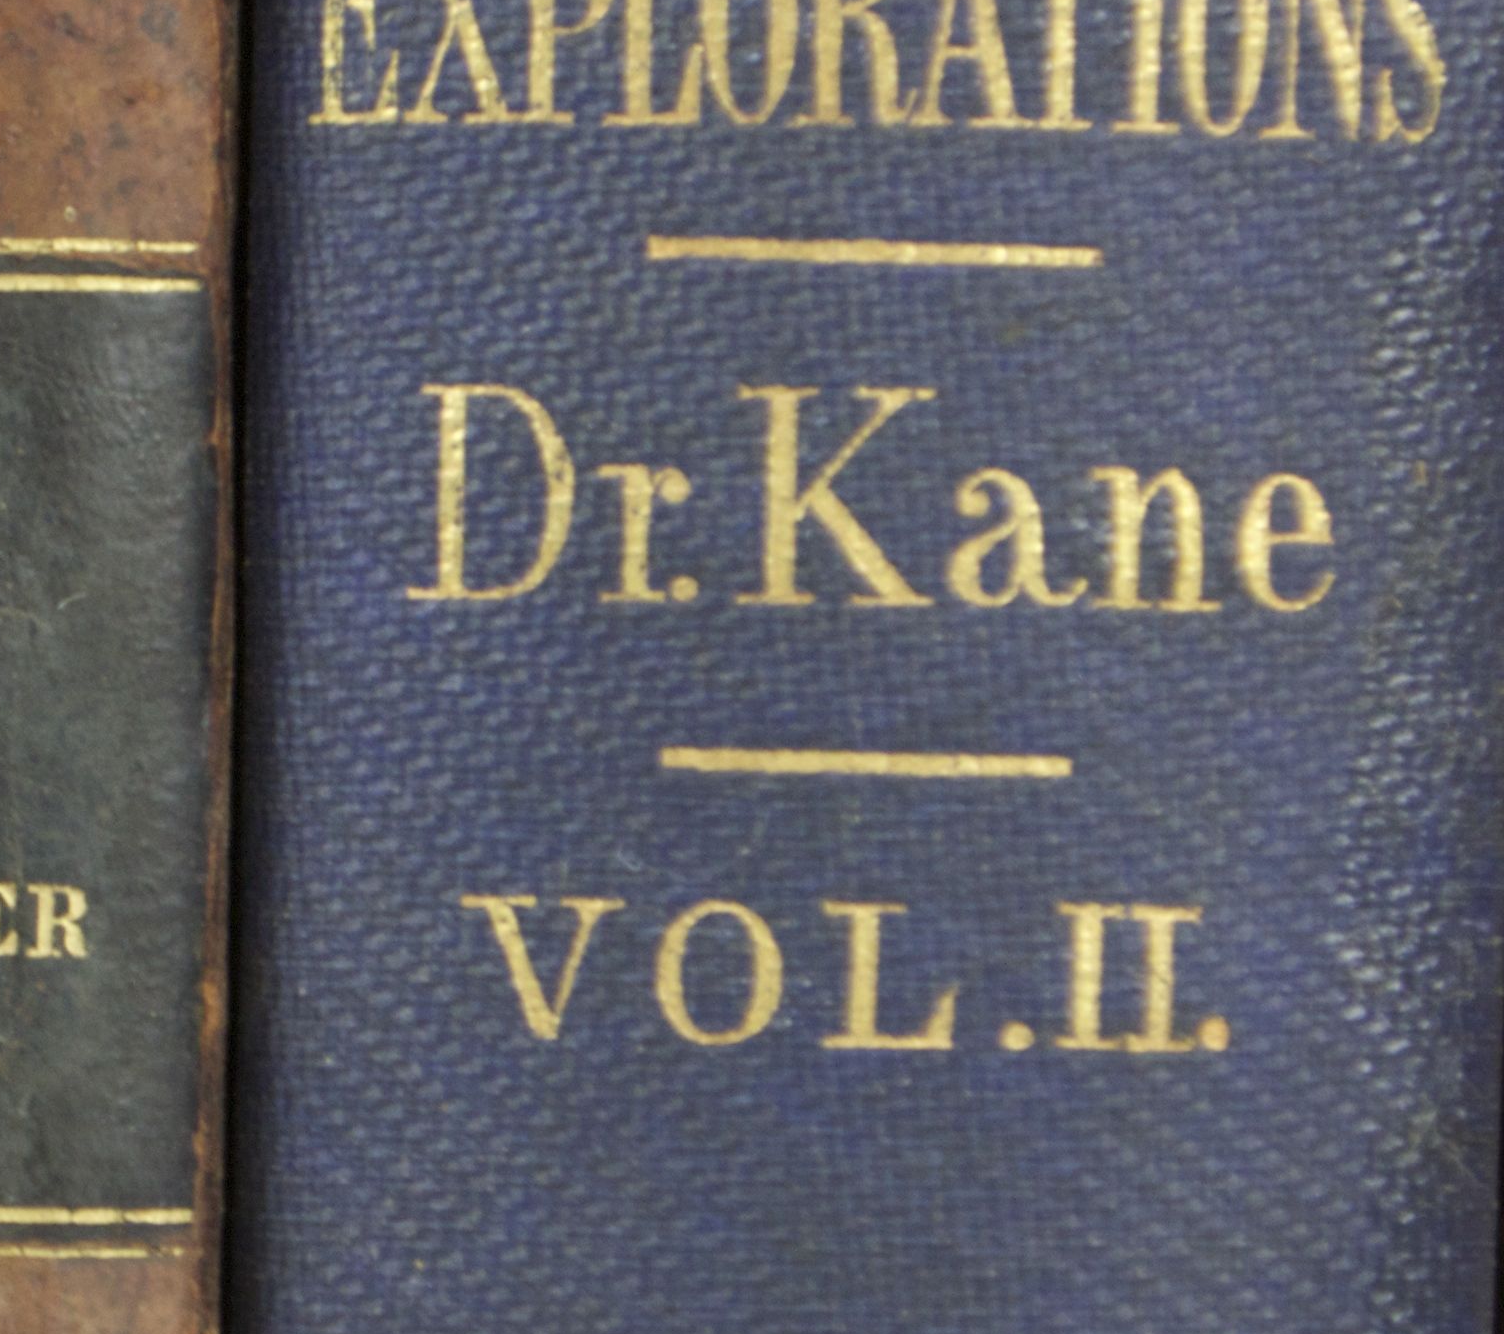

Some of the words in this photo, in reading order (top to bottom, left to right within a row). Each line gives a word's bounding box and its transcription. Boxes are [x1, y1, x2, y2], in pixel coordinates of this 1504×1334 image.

[406, 383, 698, 604] Dr.
[737, 387, 1336, 613] Kane
[461, 896, 1034, 1053] VOL.
